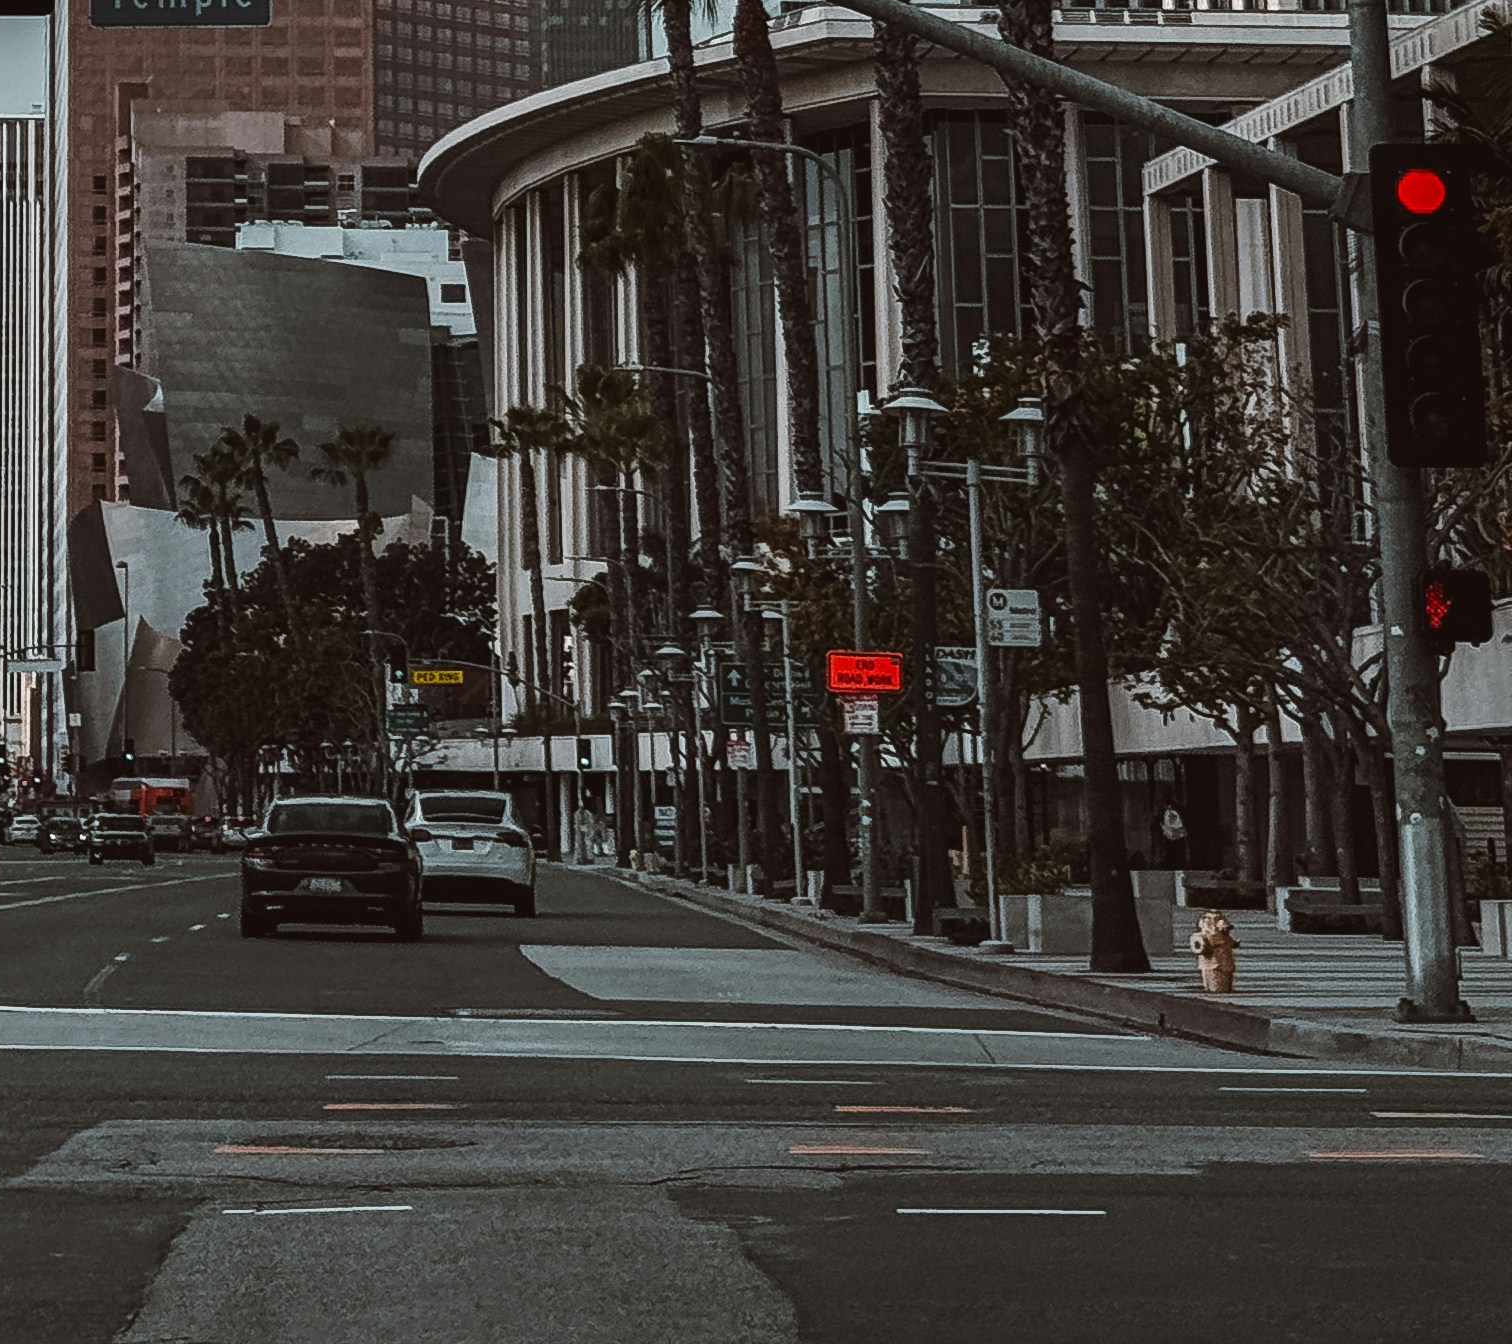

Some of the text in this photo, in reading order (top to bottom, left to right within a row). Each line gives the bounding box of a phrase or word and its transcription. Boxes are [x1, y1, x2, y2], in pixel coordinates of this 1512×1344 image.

[855, 659, 876, 671] END
[416, 673, 436, 682] PED
[836, 673, 864, 684] ROAD
